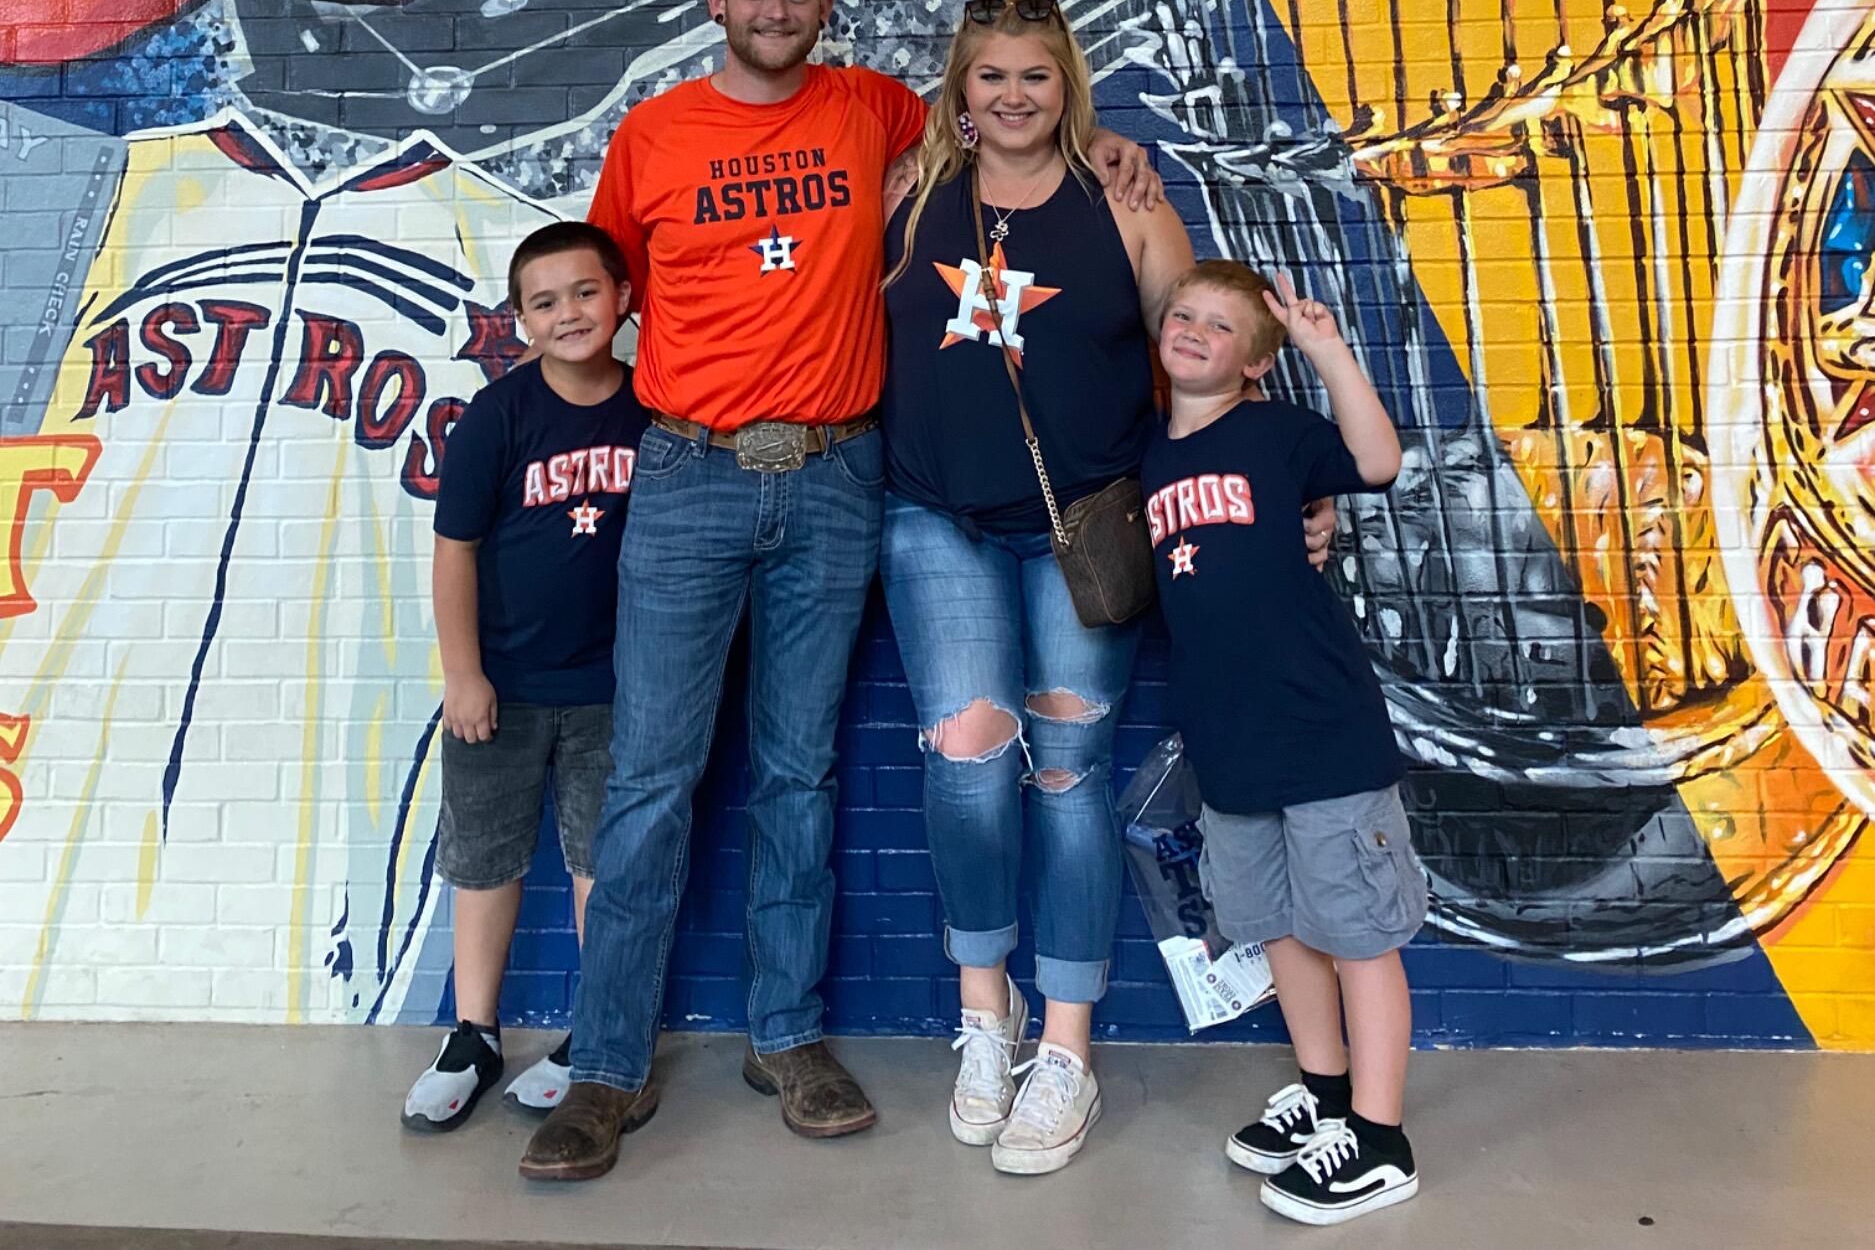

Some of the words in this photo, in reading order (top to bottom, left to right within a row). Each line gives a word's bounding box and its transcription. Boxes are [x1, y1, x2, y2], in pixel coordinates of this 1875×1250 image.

[710, 147, 826, 180] HOUSTON
[693, 169, 852, 225] ASTROS
[66, 216, 89, 262] RAIN
[38, 268, 70, 337] CHECK
[1144, 472, 1256, 550] STROS
